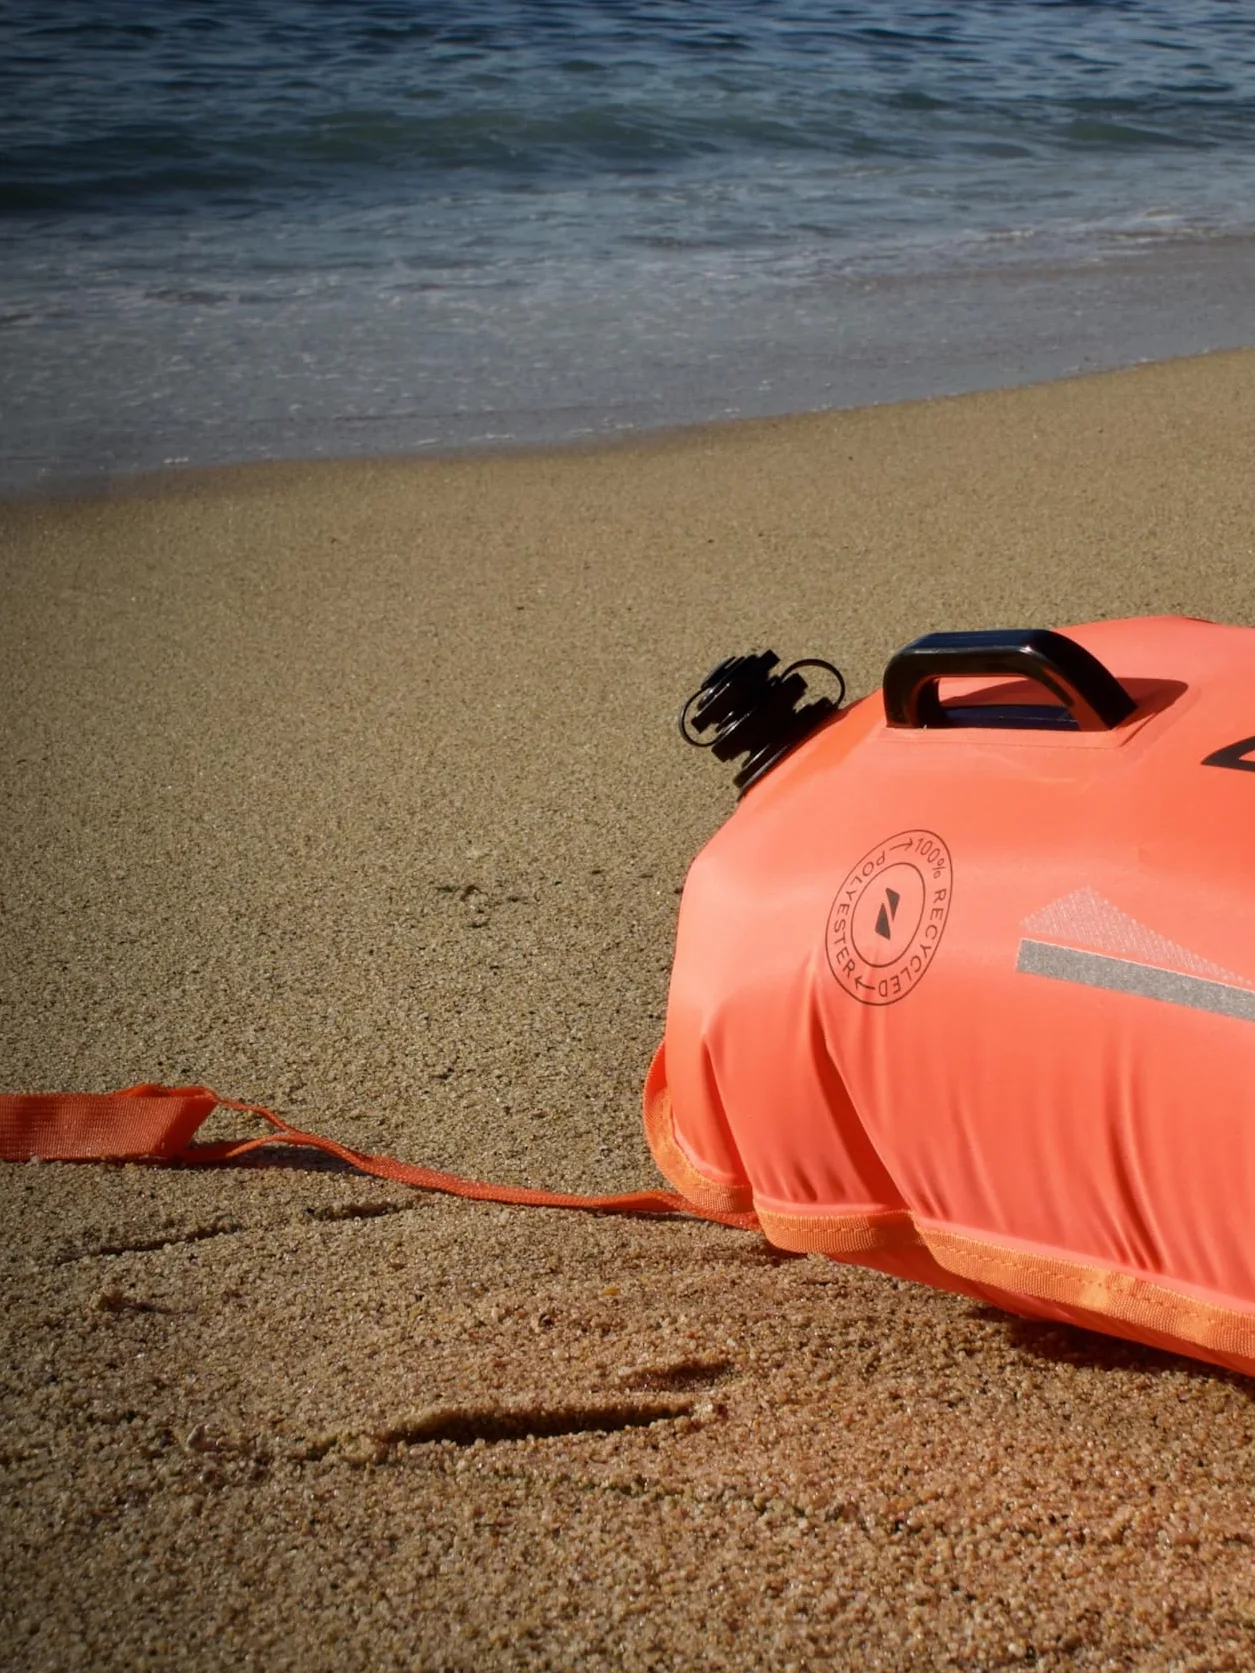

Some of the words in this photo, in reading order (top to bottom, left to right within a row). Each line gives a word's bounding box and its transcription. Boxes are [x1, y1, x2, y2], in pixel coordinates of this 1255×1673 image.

[915, 838, 947, 879] 100%
[834, 850, 886, 978] POLYESTER
[879, 888, 947, 997] RECYCLED
